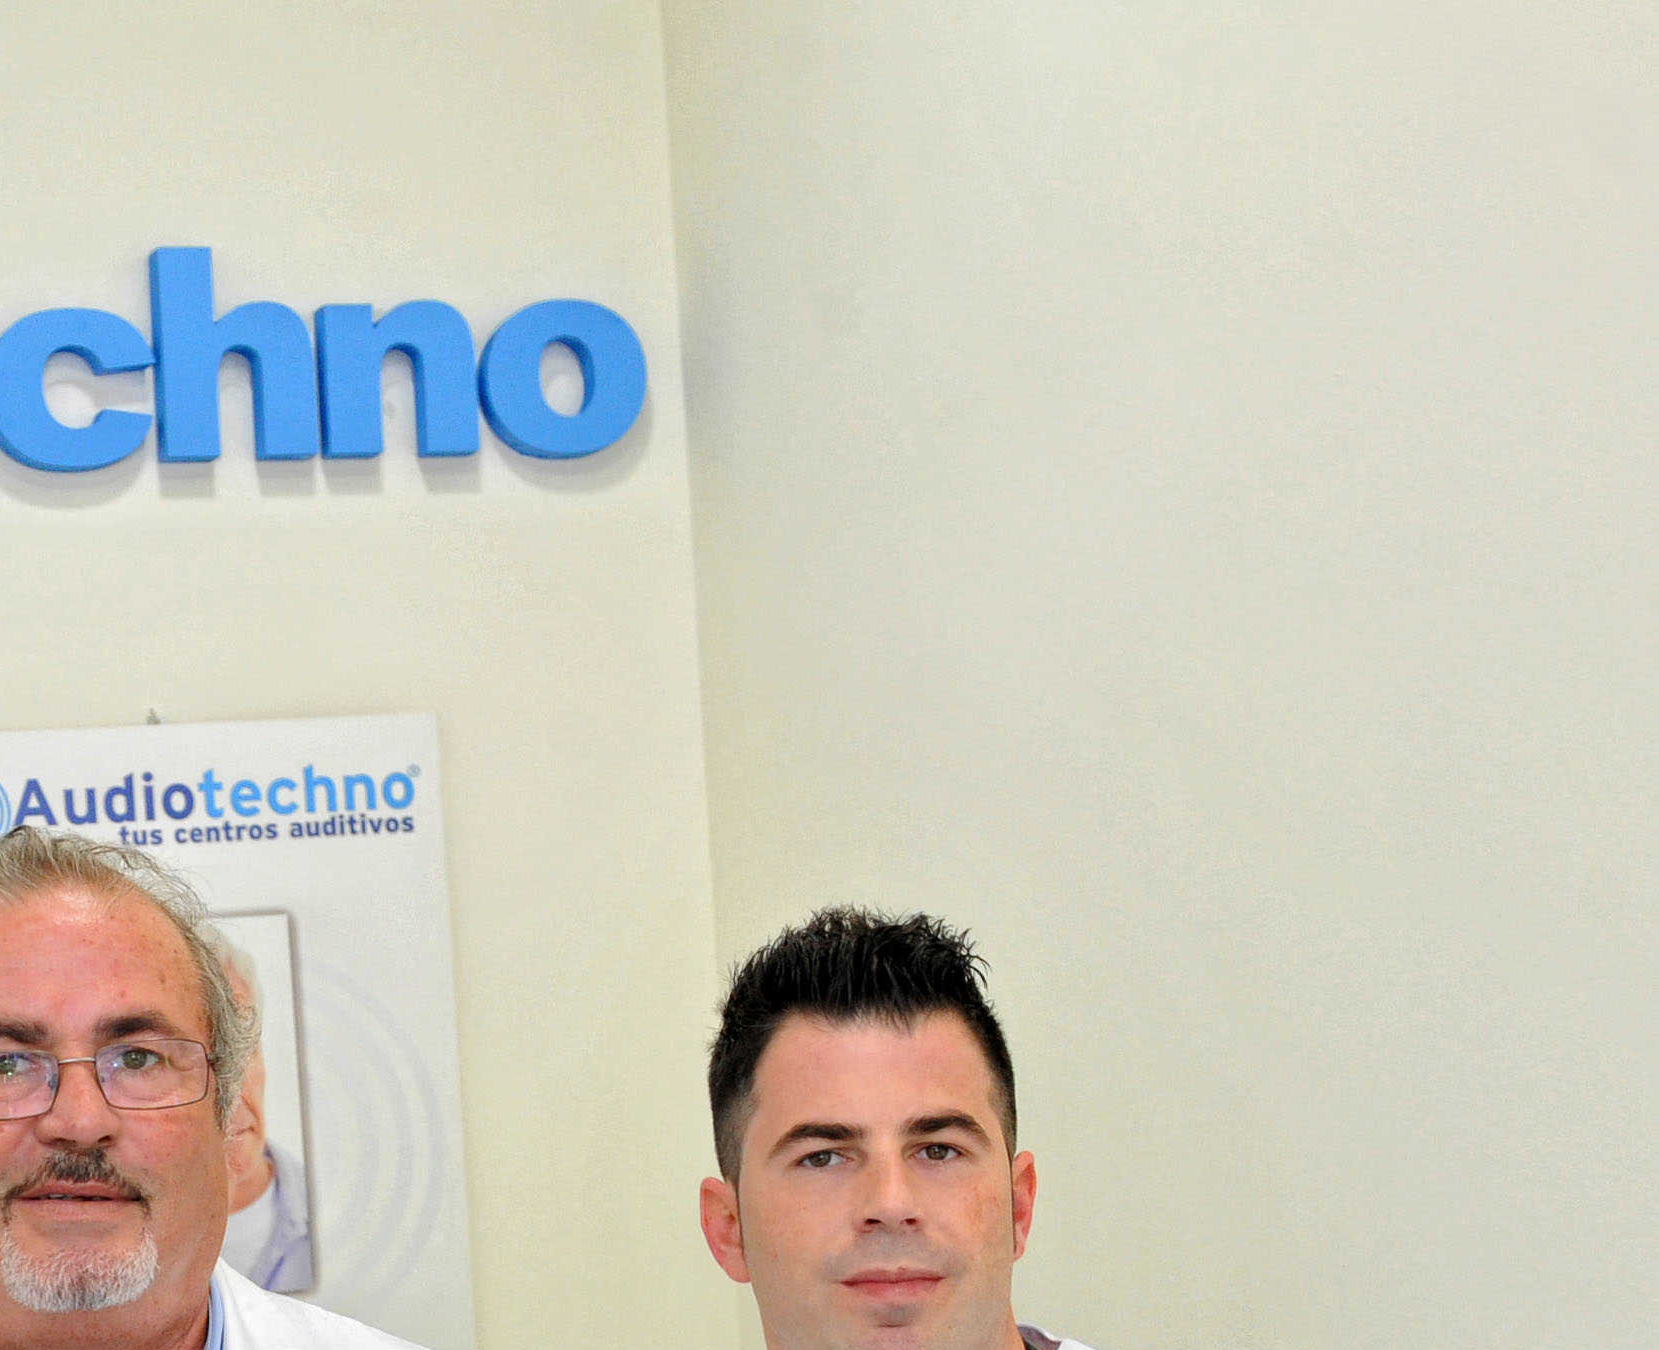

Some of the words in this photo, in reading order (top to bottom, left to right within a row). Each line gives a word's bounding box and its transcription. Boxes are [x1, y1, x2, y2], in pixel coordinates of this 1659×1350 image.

[12, 763, 417, 828] Audiotechno
[119, 825, 164, 847] tus
[174, 821, 278, 844] centros
[289, 812, 416, 838] auditivos
